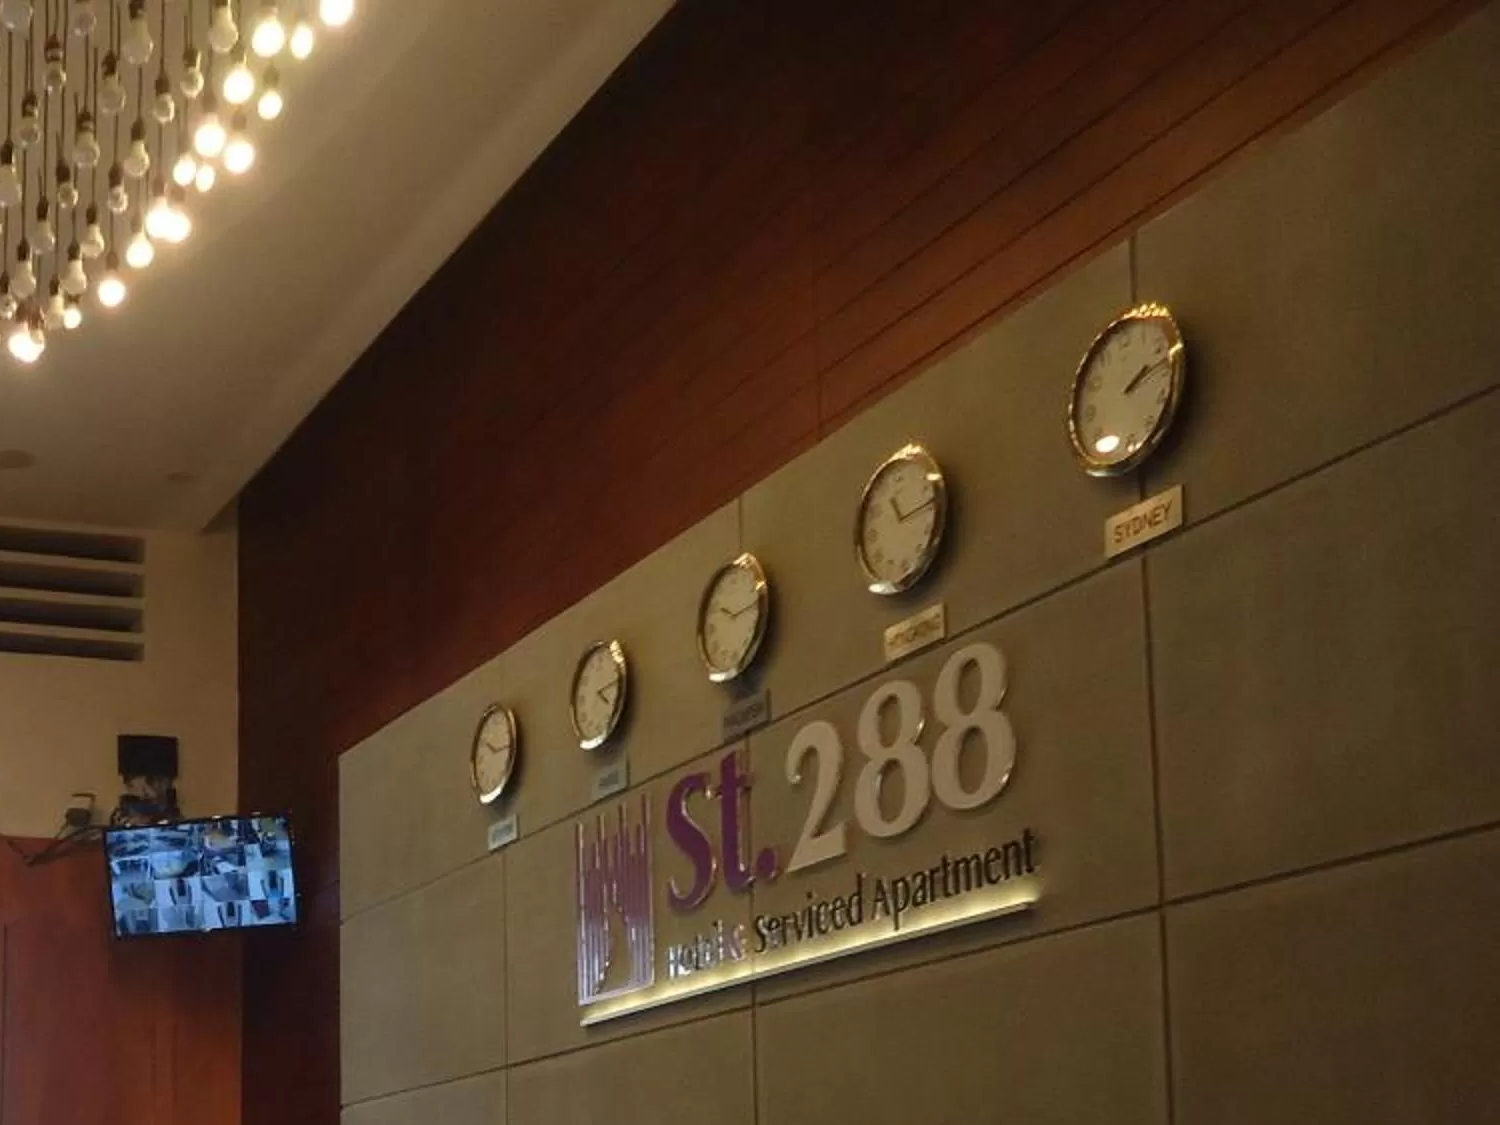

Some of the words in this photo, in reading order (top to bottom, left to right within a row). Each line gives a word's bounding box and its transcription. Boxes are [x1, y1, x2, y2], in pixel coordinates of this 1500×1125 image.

[1113, 498, 1174, 544] SYDNEY
[666, 751, 780, 911] St.
[785, 642, 1018, 875] 288
[754, 872, 866, 953] Serviced
[871, 827, 1037, 931] Apartment
